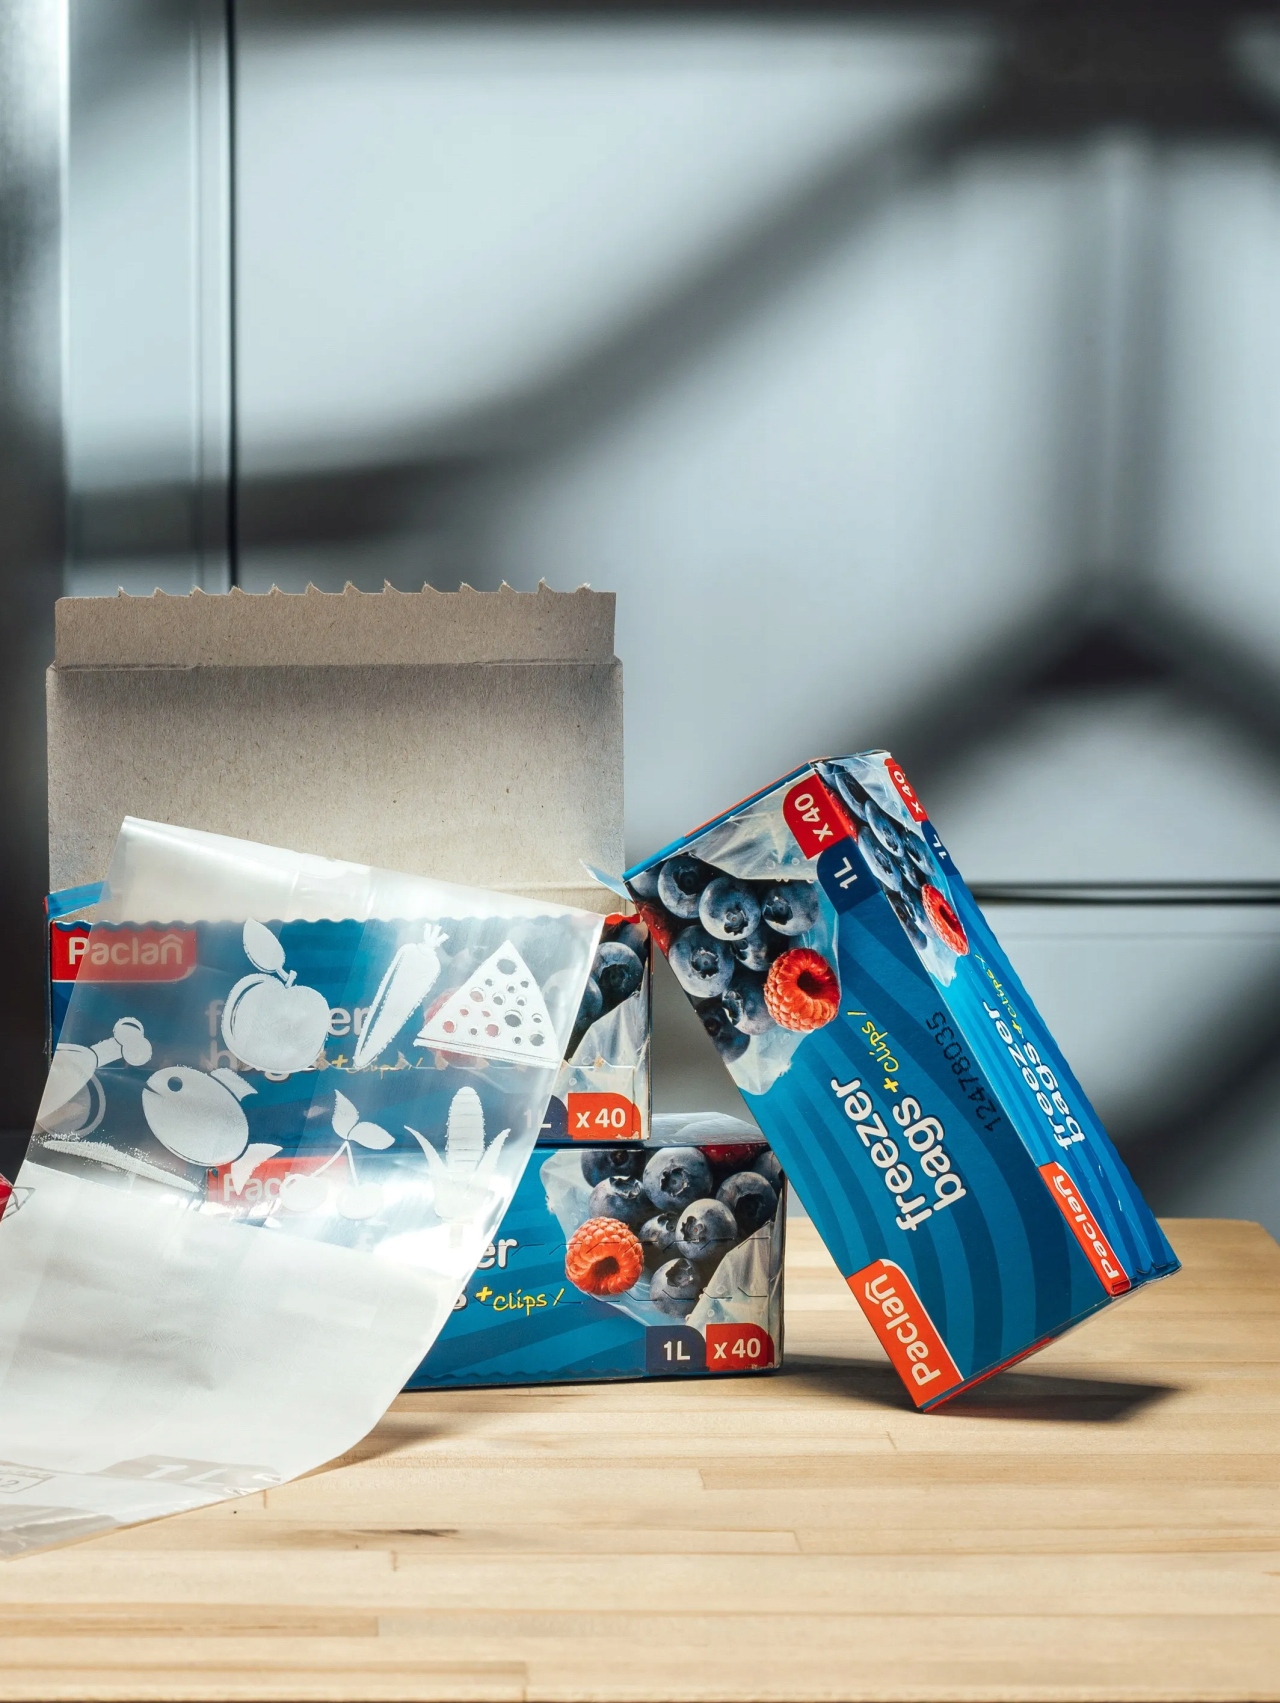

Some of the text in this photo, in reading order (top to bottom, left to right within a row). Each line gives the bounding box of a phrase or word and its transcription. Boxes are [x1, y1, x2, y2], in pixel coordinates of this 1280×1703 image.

[833, 856, 858, 890] 1L
[933, 834, 947, 860] 1L
[926, 1011, 1002, 1132] 12478035
[982, 1001, 1073, 1151] freezer
[1023, 1042, 1086, 1143] bags
[830, 1079, 933, 1232] freezer
[892, 1097, 967, 1211] bags
[663, 1340, 691, 1361] 1L
